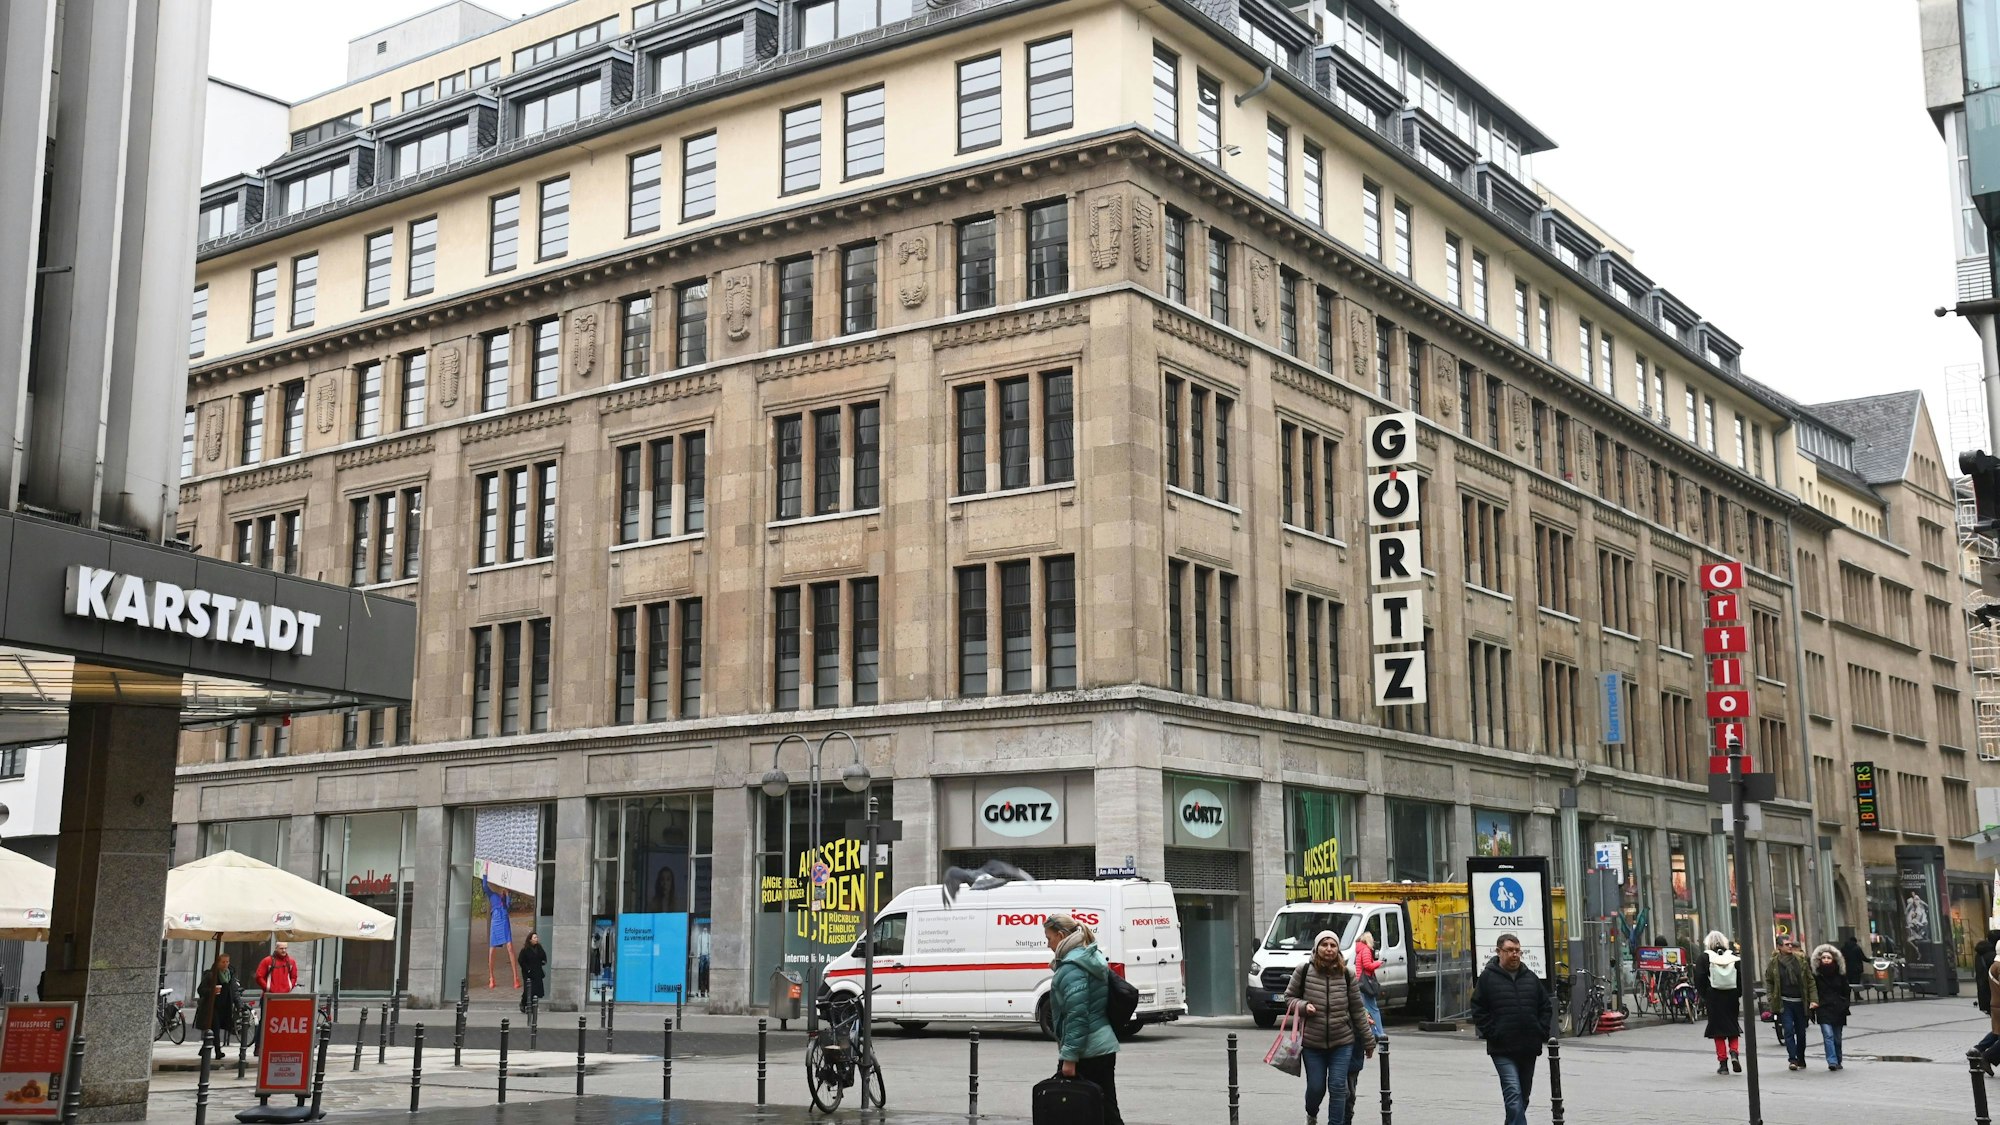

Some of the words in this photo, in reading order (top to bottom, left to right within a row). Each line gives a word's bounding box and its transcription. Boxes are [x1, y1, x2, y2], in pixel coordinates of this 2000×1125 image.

[69, 564, 321, 656] KARSTADT
[1605, 674, 1620, 742] Barmenia
[1857, 766, 1875, 819] BUTLERS
[984, 801, 1052, 823] GÖRTZ
[1183, 801, 1222, 824] GÖRTZ
[1303, 838, 1338, 877] AUSSER
[350, 869, 391, 895] Ortloff
[762, 876, 782, 889] ANGIE
[829, 913, 860, 923] RÜCKBLICK
[997, 913, 1047, 926] neon
[1132, 918, 1153, 926] neon
[1154, 915, 1170, 925] reiss
[1493, 916, 1523, 926] ZONE
[829, 924, 856, 934] EINBLICK
[828, 934, 856, 944] AUSBLICK
[1015, 940, 1042, 948] Stuttgart
[9, 1021, 51, 1029] MITTAGSPAUSE
[269, 1016, 308, 1034] SALE
